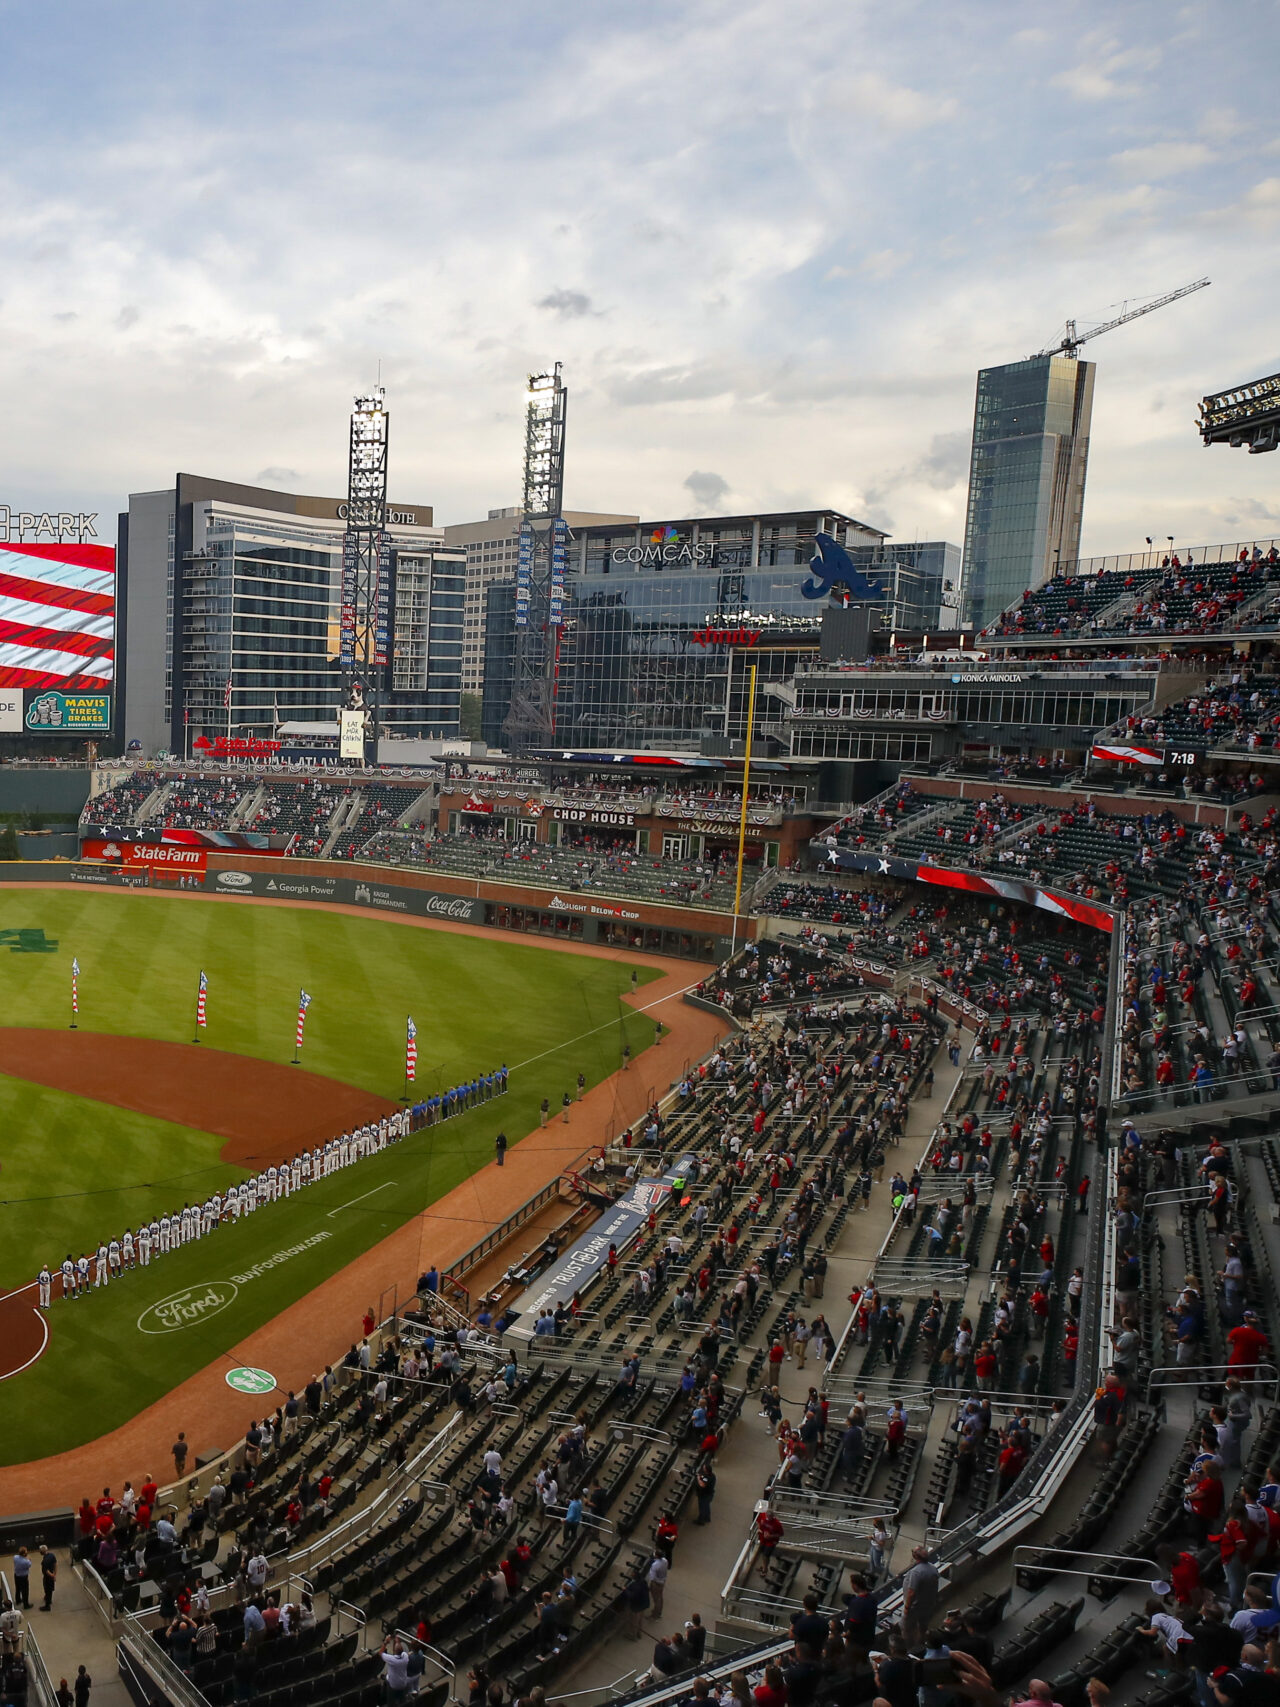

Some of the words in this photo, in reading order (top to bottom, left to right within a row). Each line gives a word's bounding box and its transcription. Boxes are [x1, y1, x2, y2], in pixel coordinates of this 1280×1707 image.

[19, 513, 99, 536] PARK
[385, 508, 419, 525] HOTEL
[612, 542, 719, 564] COMCAST
[691, 625, 762, 648] xfinity
[961, 674, 988, 682] KONICA
[989, 674, 1022, 682] MINOLTA
[65, 699, 105, 707] MAVIS
[1171, 752, 1195, 764] 7:18
[553, 809, 587, 821] CHOP
[591, 813, 635, 826] HOUSE
[678, 822, 690, 830] THE
[691, 821, 735, 835] Silver
[735, 828, 762, 836] BLLET
[225, 874, 245, 883] Ford
[279, 883, 309, 895] Georgia
[311, 885, 335, 895] Power
[427, 896, 474, 918] Coca-Cola
[591, 906, 614, 915] BELOW
[621, 910, 639, 919] CHOP
[229, 1231, 333, 1285] BuyFordNow.com
[552, 1260, 585, 1286] TRUIST
[584, 1236, 611, 1254] PARK
[154, 1288, 225, 1327] Ford
[526, 1293, 552, 1314] WELCOME
